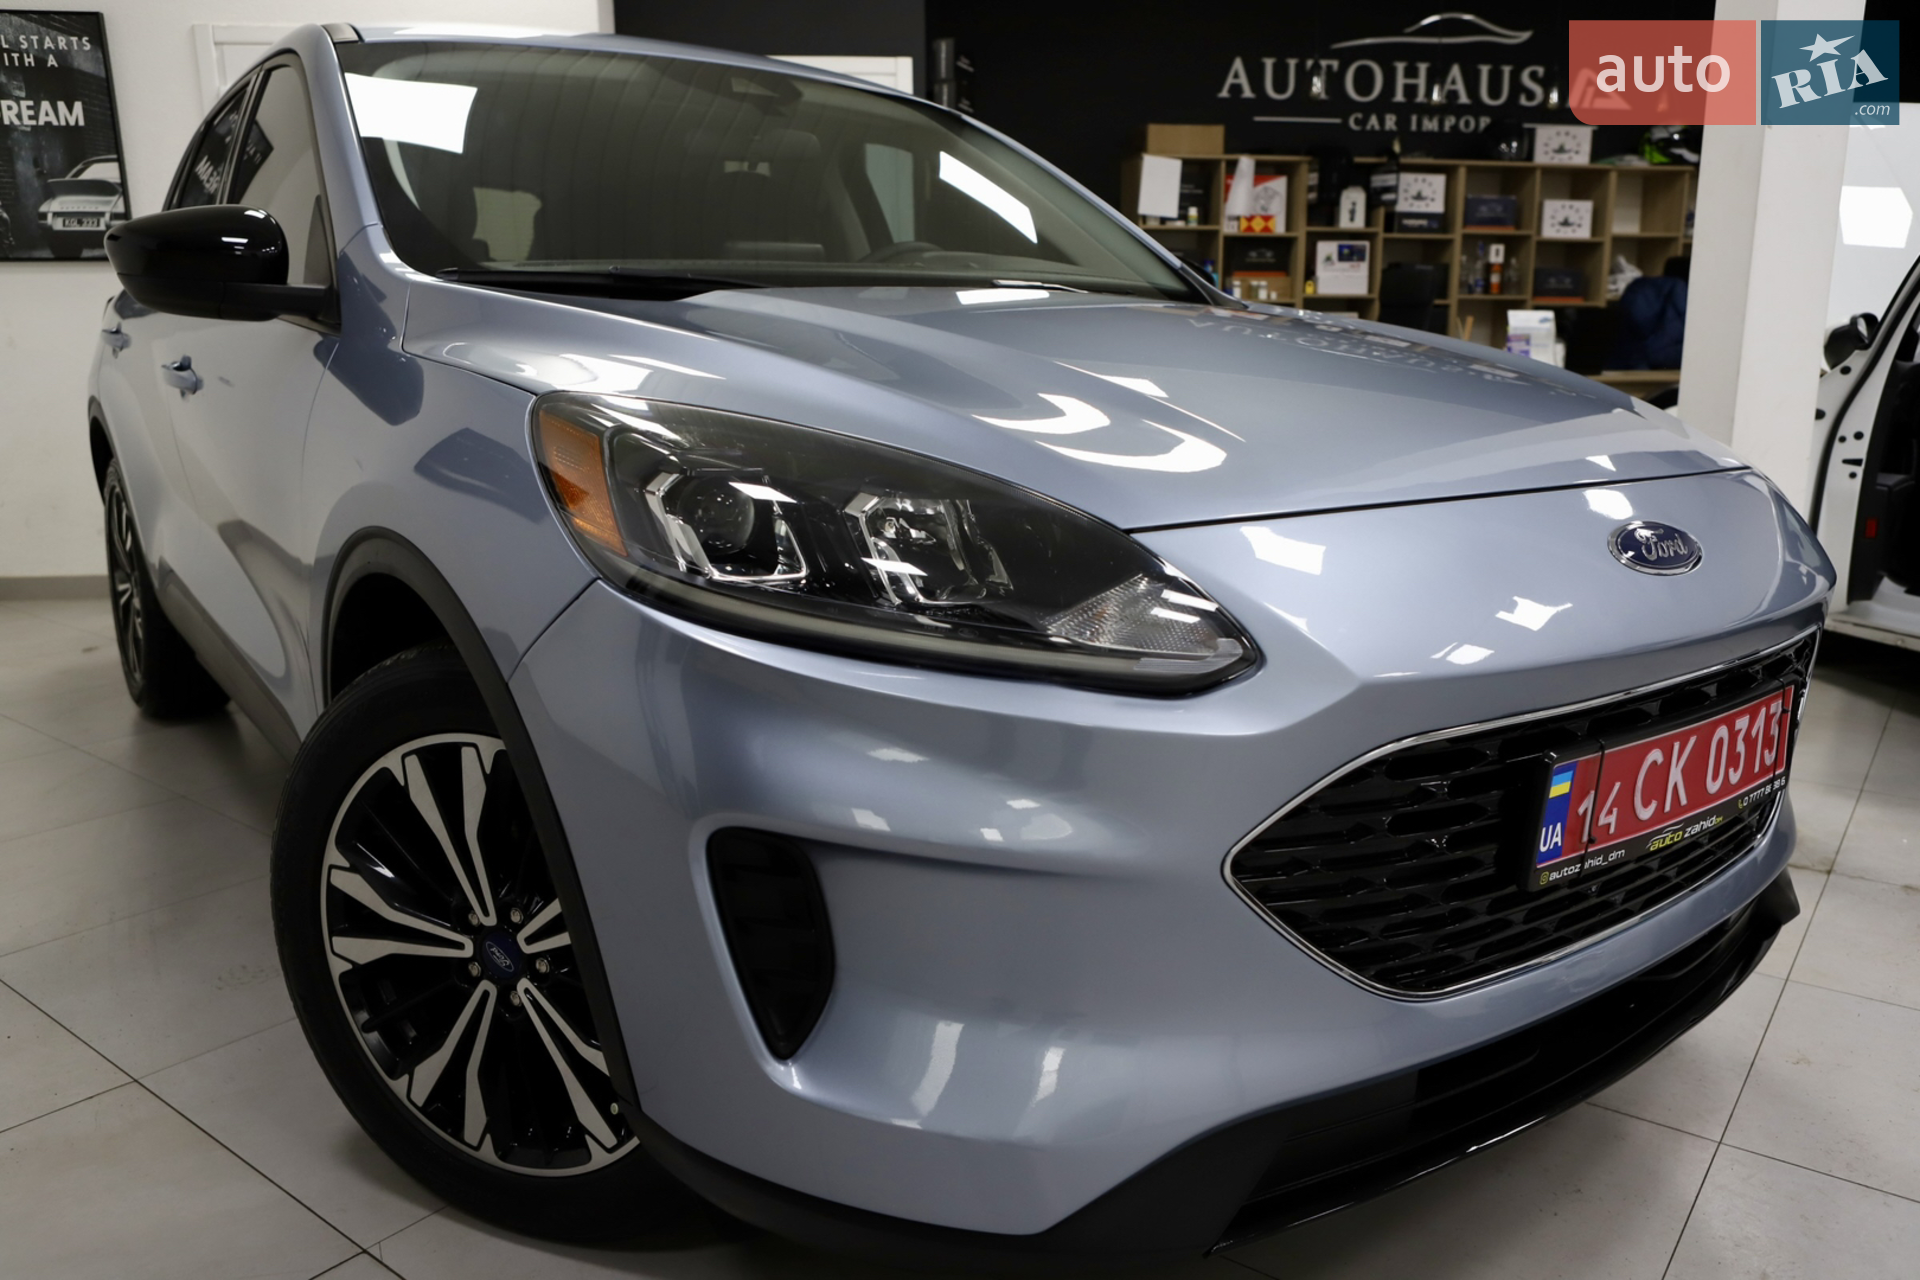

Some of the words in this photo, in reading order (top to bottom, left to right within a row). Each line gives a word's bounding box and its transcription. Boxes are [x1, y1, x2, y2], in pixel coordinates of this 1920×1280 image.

[0, 34, 9, 49] L
[19, 34, 92, 51] STARTS
[3, 52, 35, 67] ITH
[47, 54, 59, 68] A
[1217, 57, 1546, 107] AUTOHAUS
[0, 99, 85, 127] REAM
[1348, 112, 1398, 132] CAR
[1410, 114, 1492, 133] IMPOR
[1634, 528, 1689, 561] Ford
[1577, 781, 1622, 843] 14
[1633, 735, 1698, 821] CK
[1705, 699, 1783, 795] 0313
[1539, 823, 1562, 853] UA
[1650, 831, 1683, 851] auto
[1684, 815, 1717, 838] zahid
